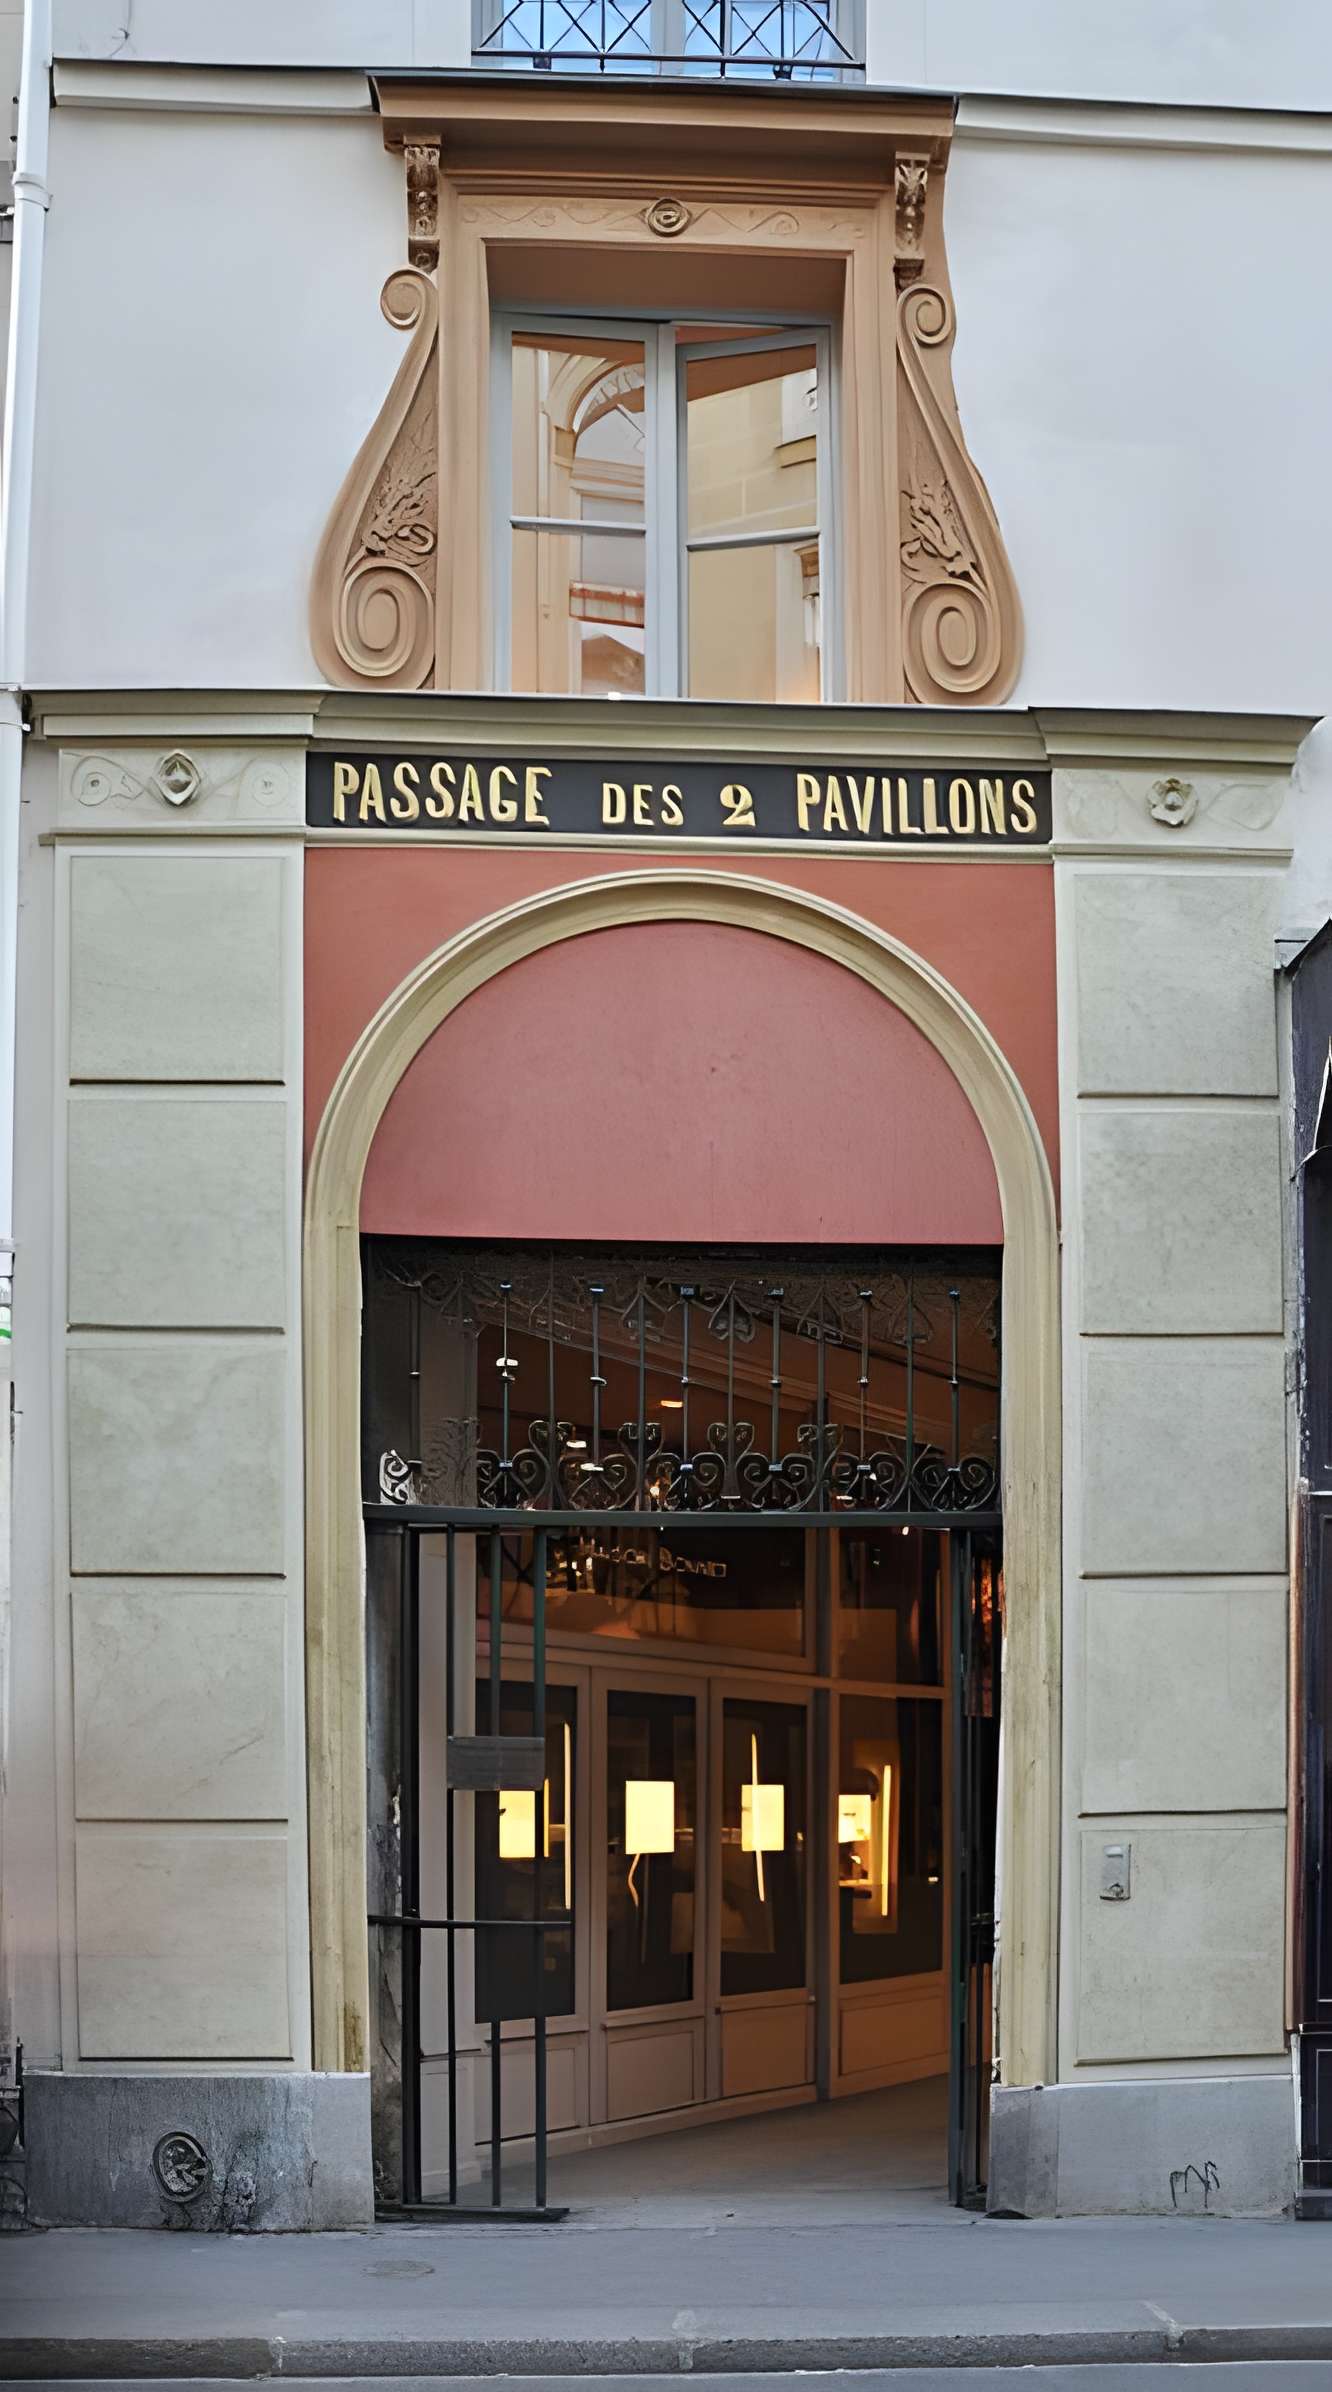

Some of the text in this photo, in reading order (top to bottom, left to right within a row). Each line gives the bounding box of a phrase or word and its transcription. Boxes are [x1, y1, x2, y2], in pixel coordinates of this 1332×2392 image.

[333, 761, 1038, 835] PASSAGE DES 2 PAVILLONS
